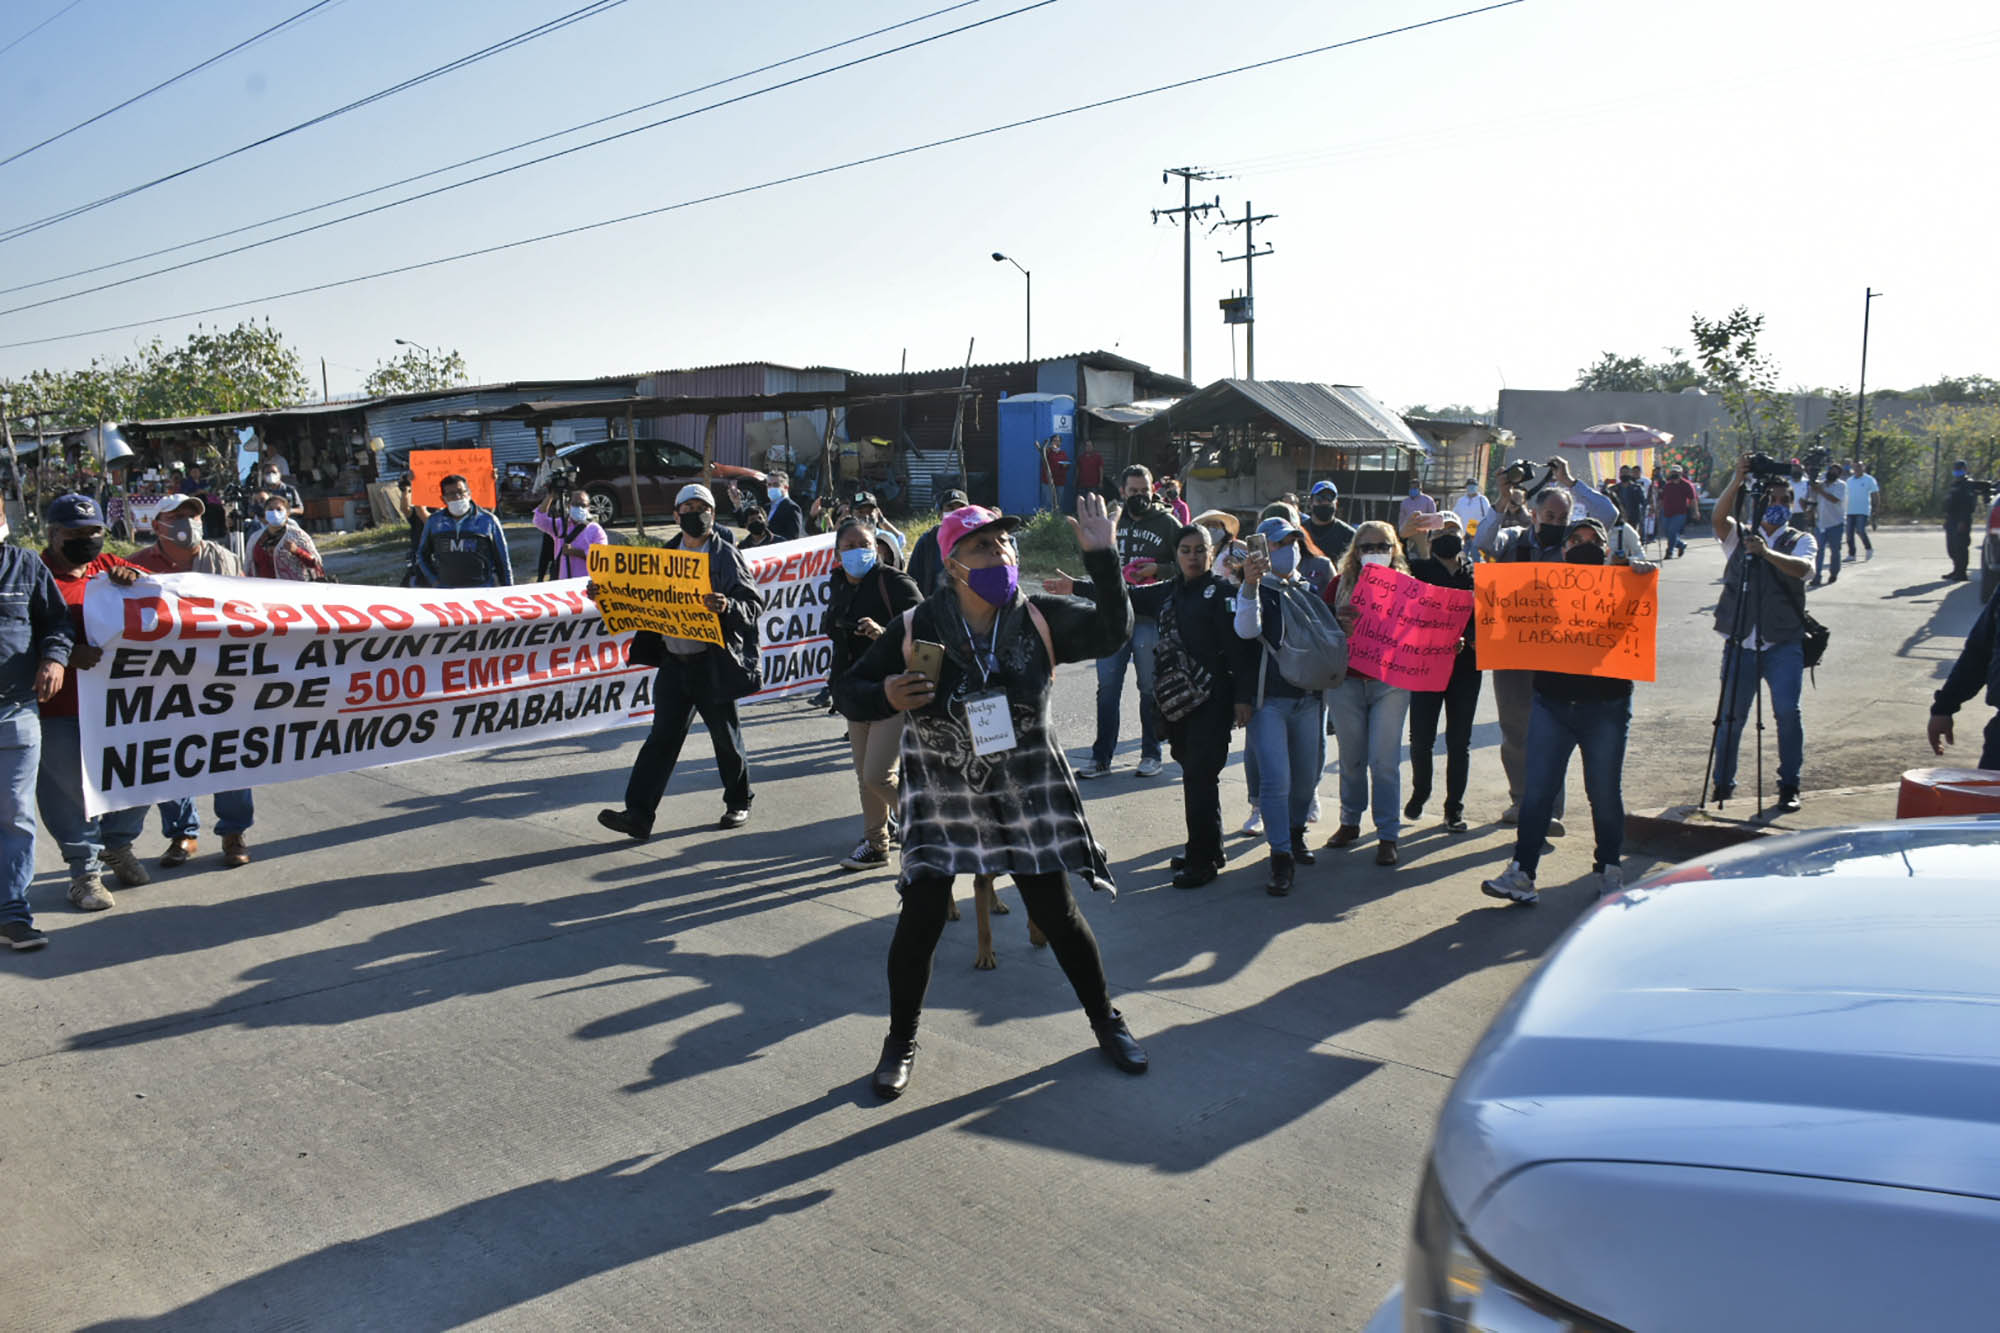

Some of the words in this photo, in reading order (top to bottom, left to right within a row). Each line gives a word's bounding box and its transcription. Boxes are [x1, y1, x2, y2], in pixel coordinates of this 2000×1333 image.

[589, 550, 609, 573] Un
[615, 552, 660, 575] BUEN
[664, 555, 701, 579] JUEZ
[122, 596, 415, 642] DESPIDO
[420, 588, 588, 628] MASIV
[750, 548, 842, 584] DEMI
[608, 581, 706, 605] Independient
[1484, 590, 1560, 609] Violaste
[1571, 594, 1586, 611] el
[1625, 599, 1652, 617] 123
[609, 599, 671, 620] imparcial
[672, 611, 681, 624] y
[681, 609, 715, 624] tiene
[1481, 613, 1497, 626] de
[1507, 611, 1561, 625] nuestros
[1568, 613, 1640, 633] derechos
[608, 614, 678, 635] Conciencia
[681, 623, 721, 642] Social
[110, 646, 197, 679] EN
[215, 642, 280, 677] EL
[105, 682, 237, 727] MAS
[254, 677, 331, 711] DE
[345, 664, 426, 705] 500
[102, 709, 439, 792] NECESITAMOS
[452, 680, 626, 739] TRABAJAR
